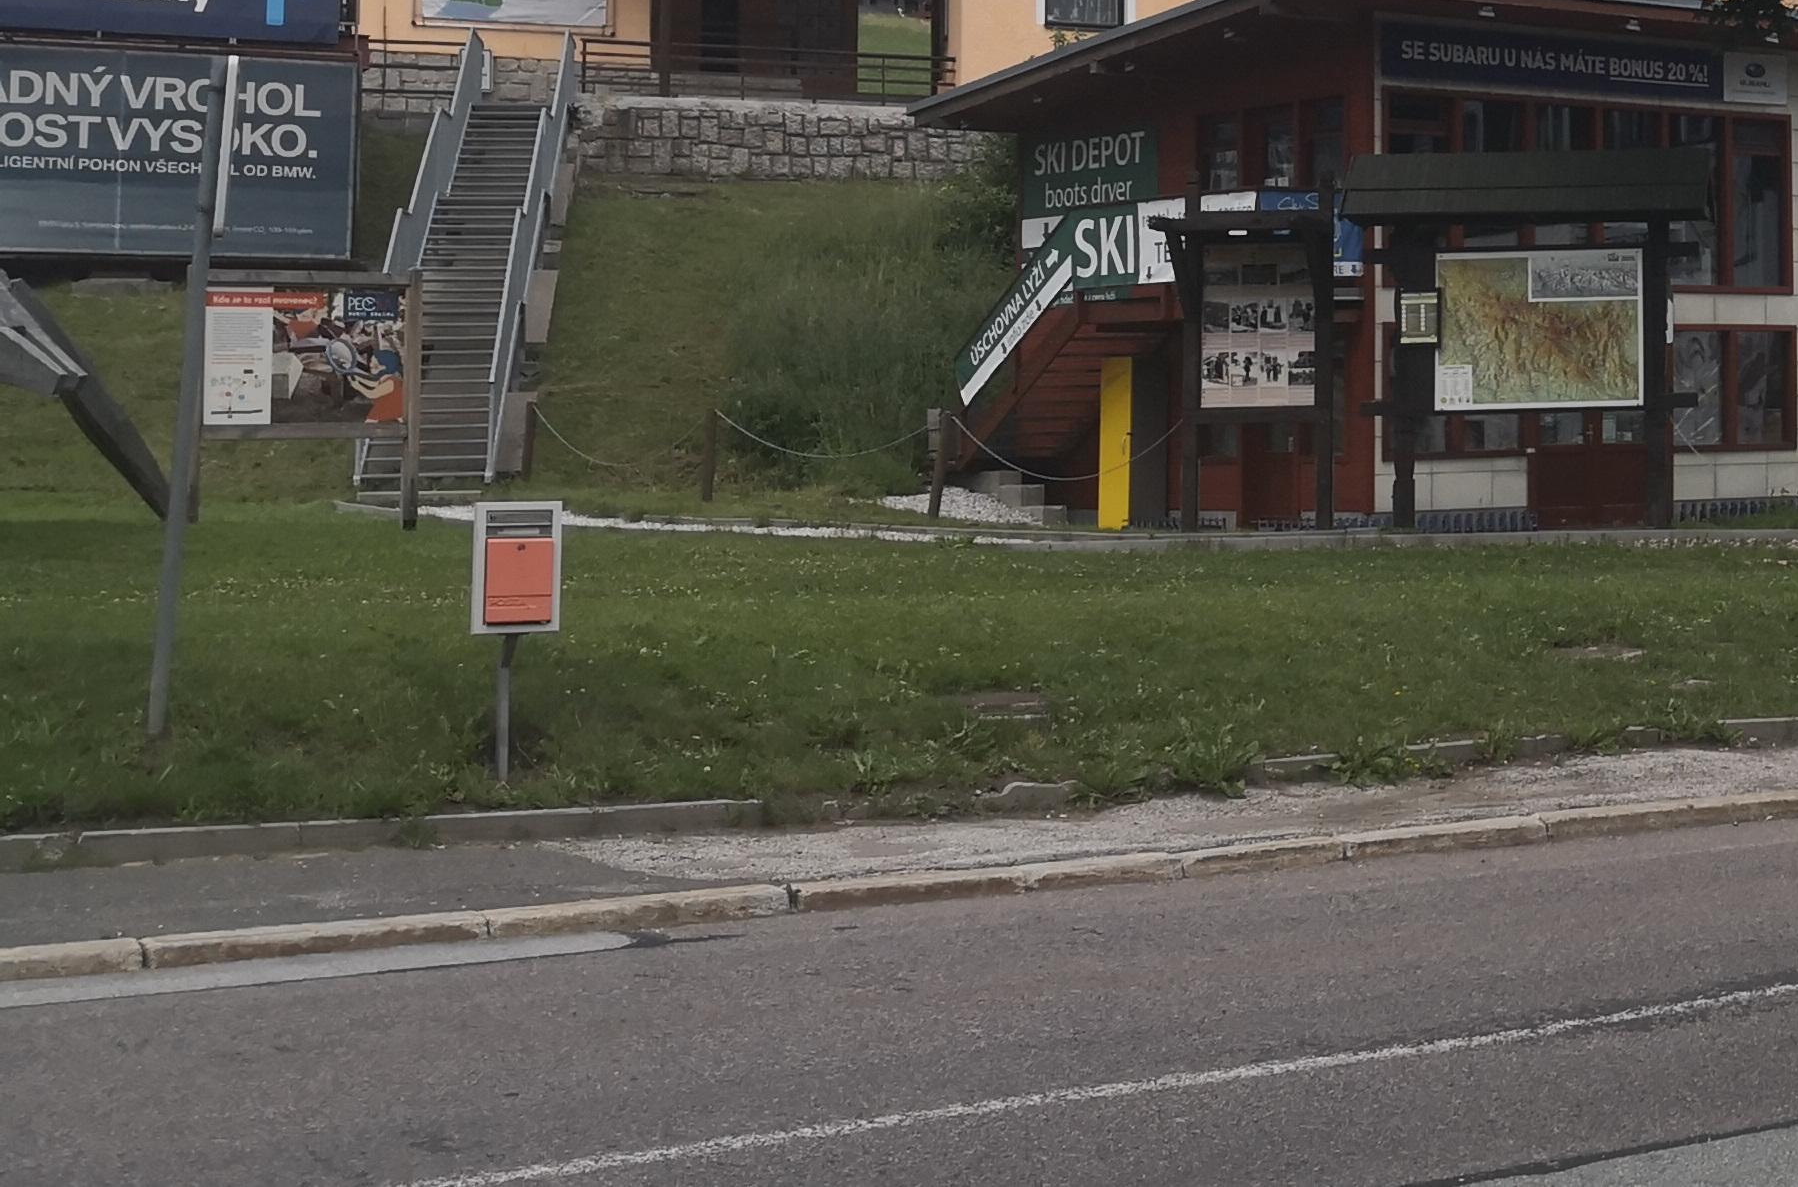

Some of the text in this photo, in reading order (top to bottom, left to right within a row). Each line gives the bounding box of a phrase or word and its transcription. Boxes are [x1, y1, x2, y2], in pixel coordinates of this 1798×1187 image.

[1401, 41, 1425, 62] SE
[1429, 43, 1500, 66] SUBARU
[1505, 49, 1516, 67] U
[1520, 47, 1556, 71] NÁS
[1560, 49, 1605, 75] MÁTE
[1609, 57, 1664, 79] BONUS
[1668, 62, 1686, 81] 20
[106, 116, 318, 158] VYSKO.
[1034, 131, 1146, 176] SKI DEPOT
[78, 158, 141, 172] POHON
[144, 159, 202, 174] VŠECH
[243, 164, 268, 177] OD
[272, 165, 317, 179] BMW.
[1045, 180, 1087, 209] boots
[1075, 214, 1135, 278] SKI
[1021, 259, 1046, 300] LYŽÍ
[347, 296, 376, 311] PEC
[969, 298, 1025, 366] ÚSCHOVNA
